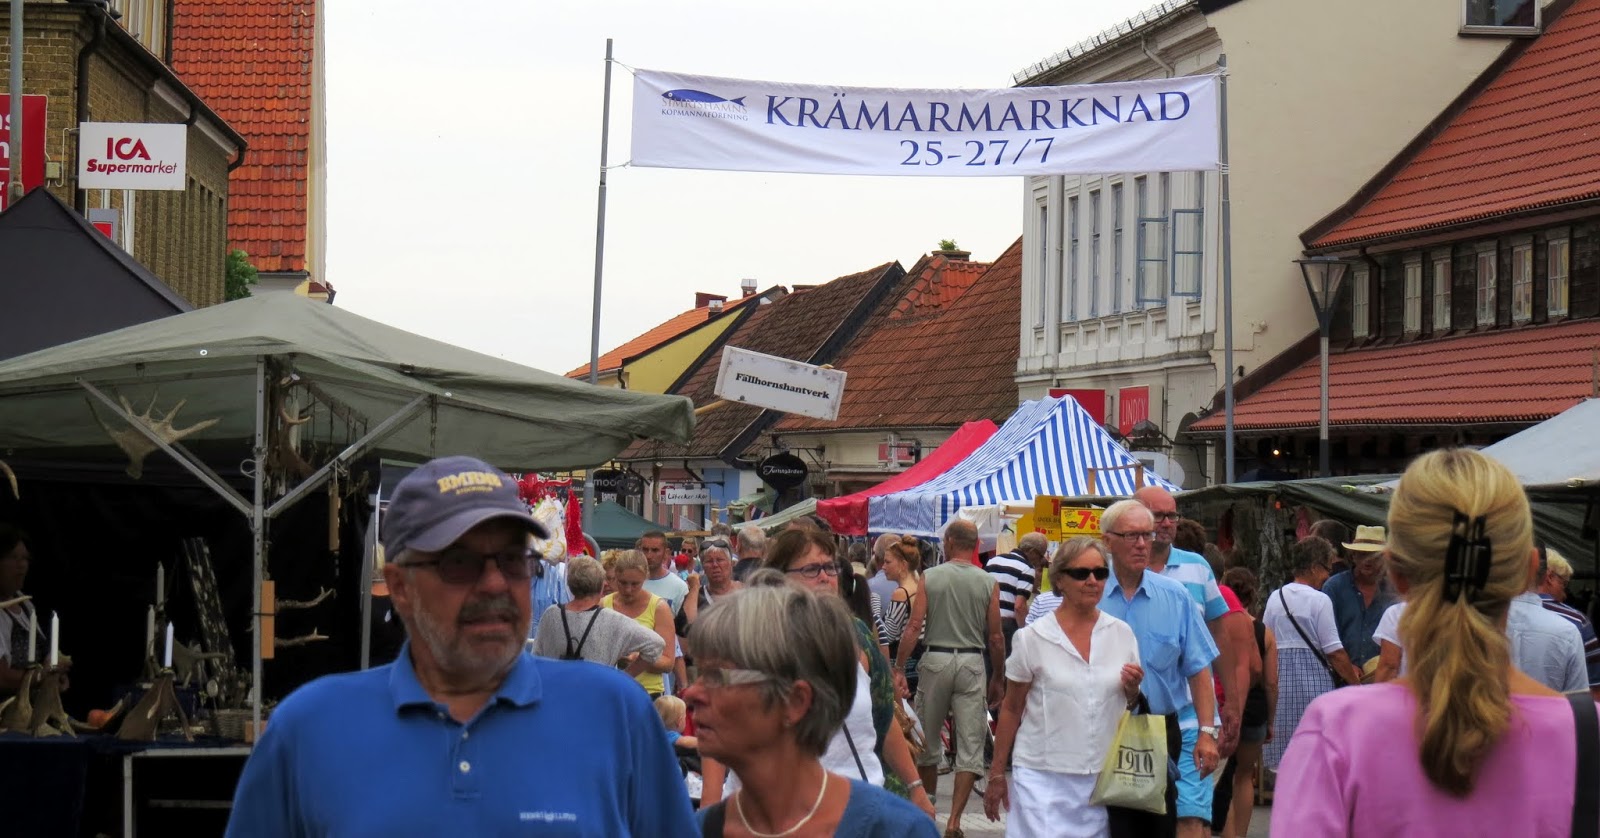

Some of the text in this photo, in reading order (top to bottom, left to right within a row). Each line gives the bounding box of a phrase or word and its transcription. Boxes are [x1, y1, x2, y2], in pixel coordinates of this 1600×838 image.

[661, 98, 749, 115] SIMRISHAMNS
[765, 91, 1191, 132] KRÄMARMARKNAD
[106, 137, 152, 161] ICA
[899, 136, 1056, 167] 25-27/7
[86, 158, 178, 176] Supermarket
[735, 371, 830, 400] Fällhornshantverk
[1116, 750, 1154, 774] 1910
